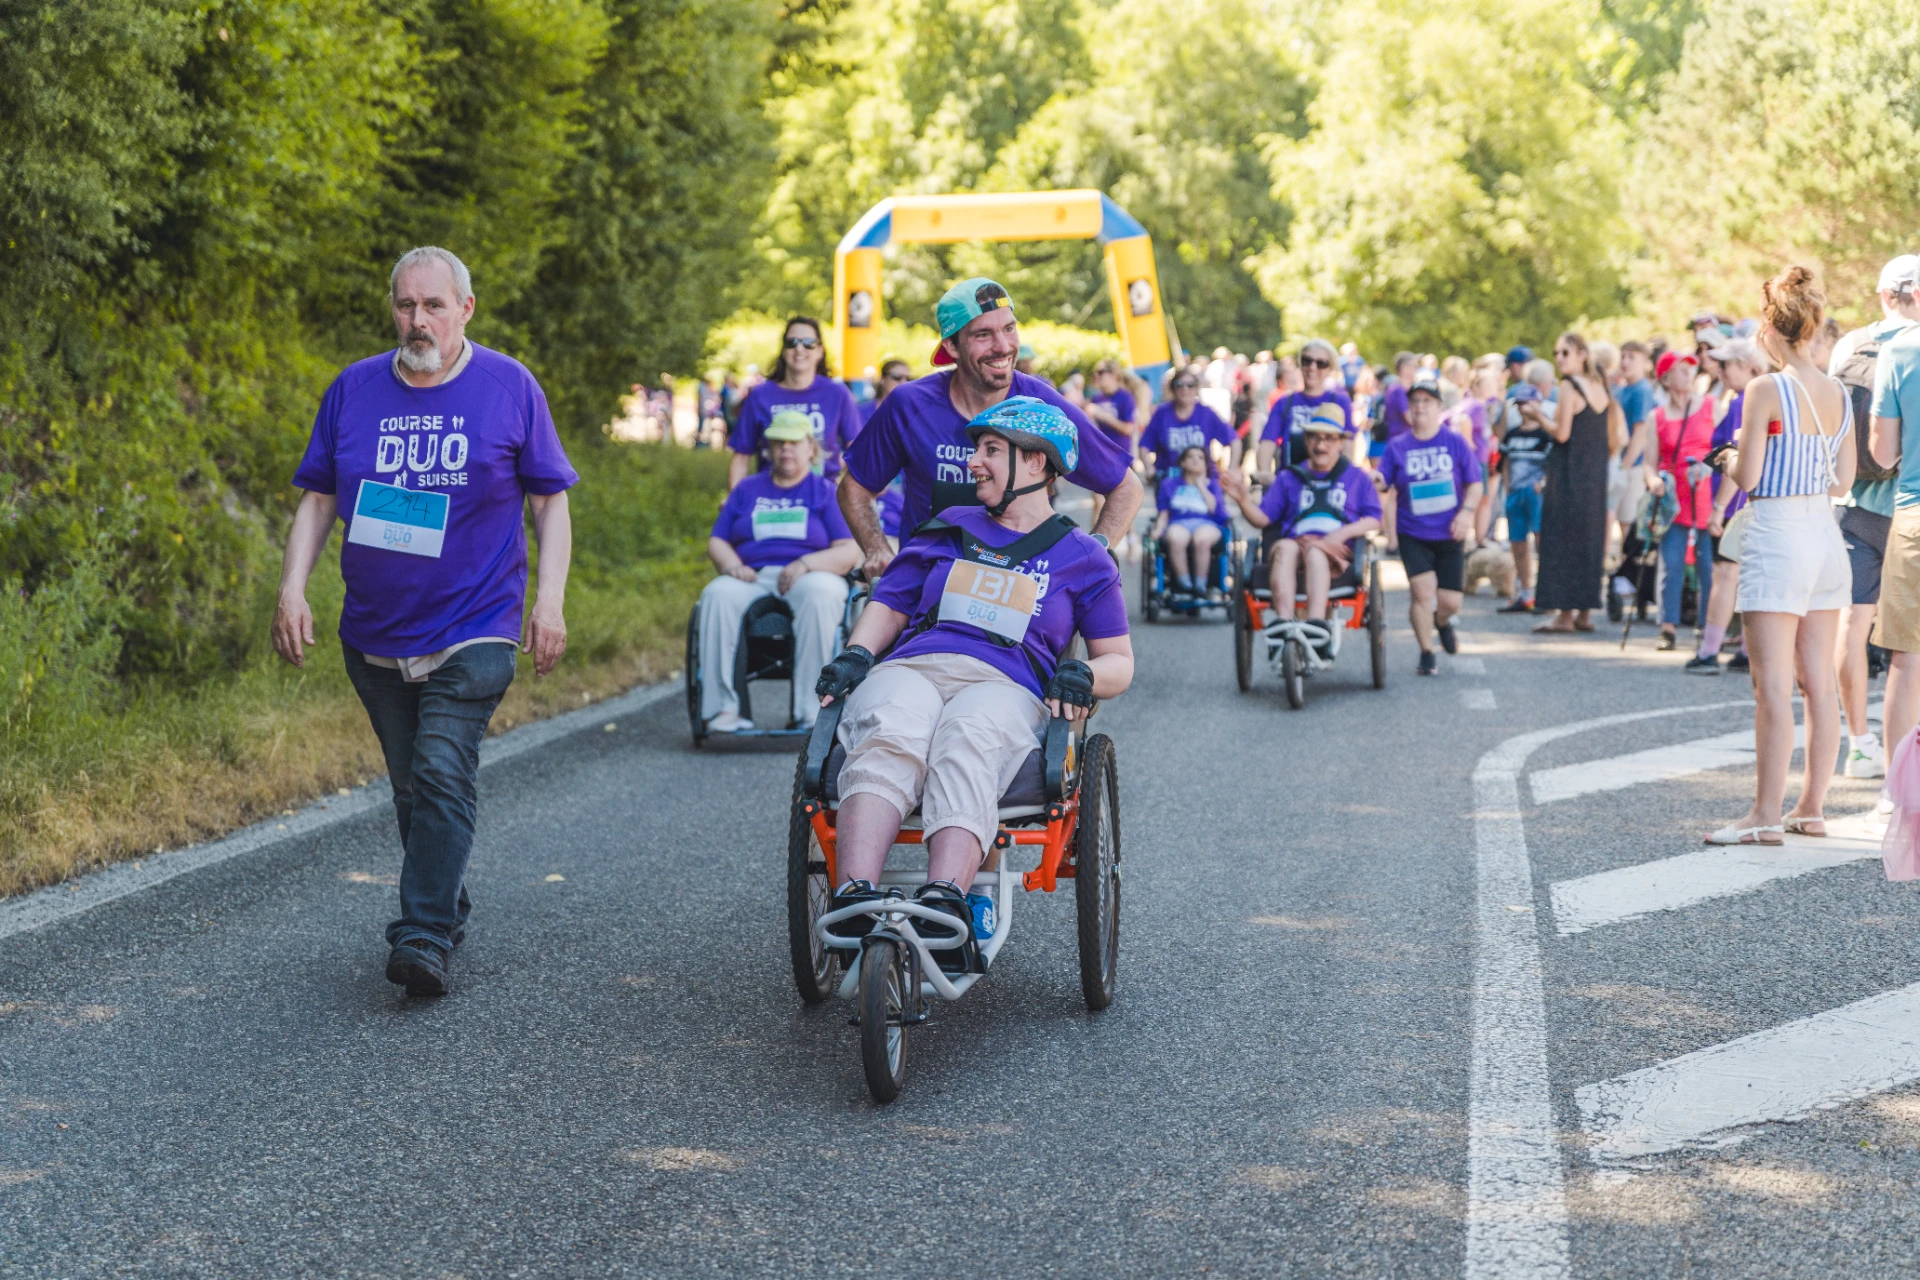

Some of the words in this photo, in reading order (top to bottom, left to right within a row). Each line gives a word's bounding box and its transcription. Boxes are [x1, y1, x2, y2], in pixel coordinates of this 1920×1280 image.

[380, 415, 443, 432] COURSE
[376, 433, 468, 472] DUO
[936, 444, 977, 462] COUR
[1406, 453, 1454, 476] DUO
[418, 472, 468, 487] SUISSE
[1299, 488, 1347, 511] DO
[383, 528, 412, 544] DUO
[970, 568, 1016, 604] 131
[967, 604, 998, 622] DUO
